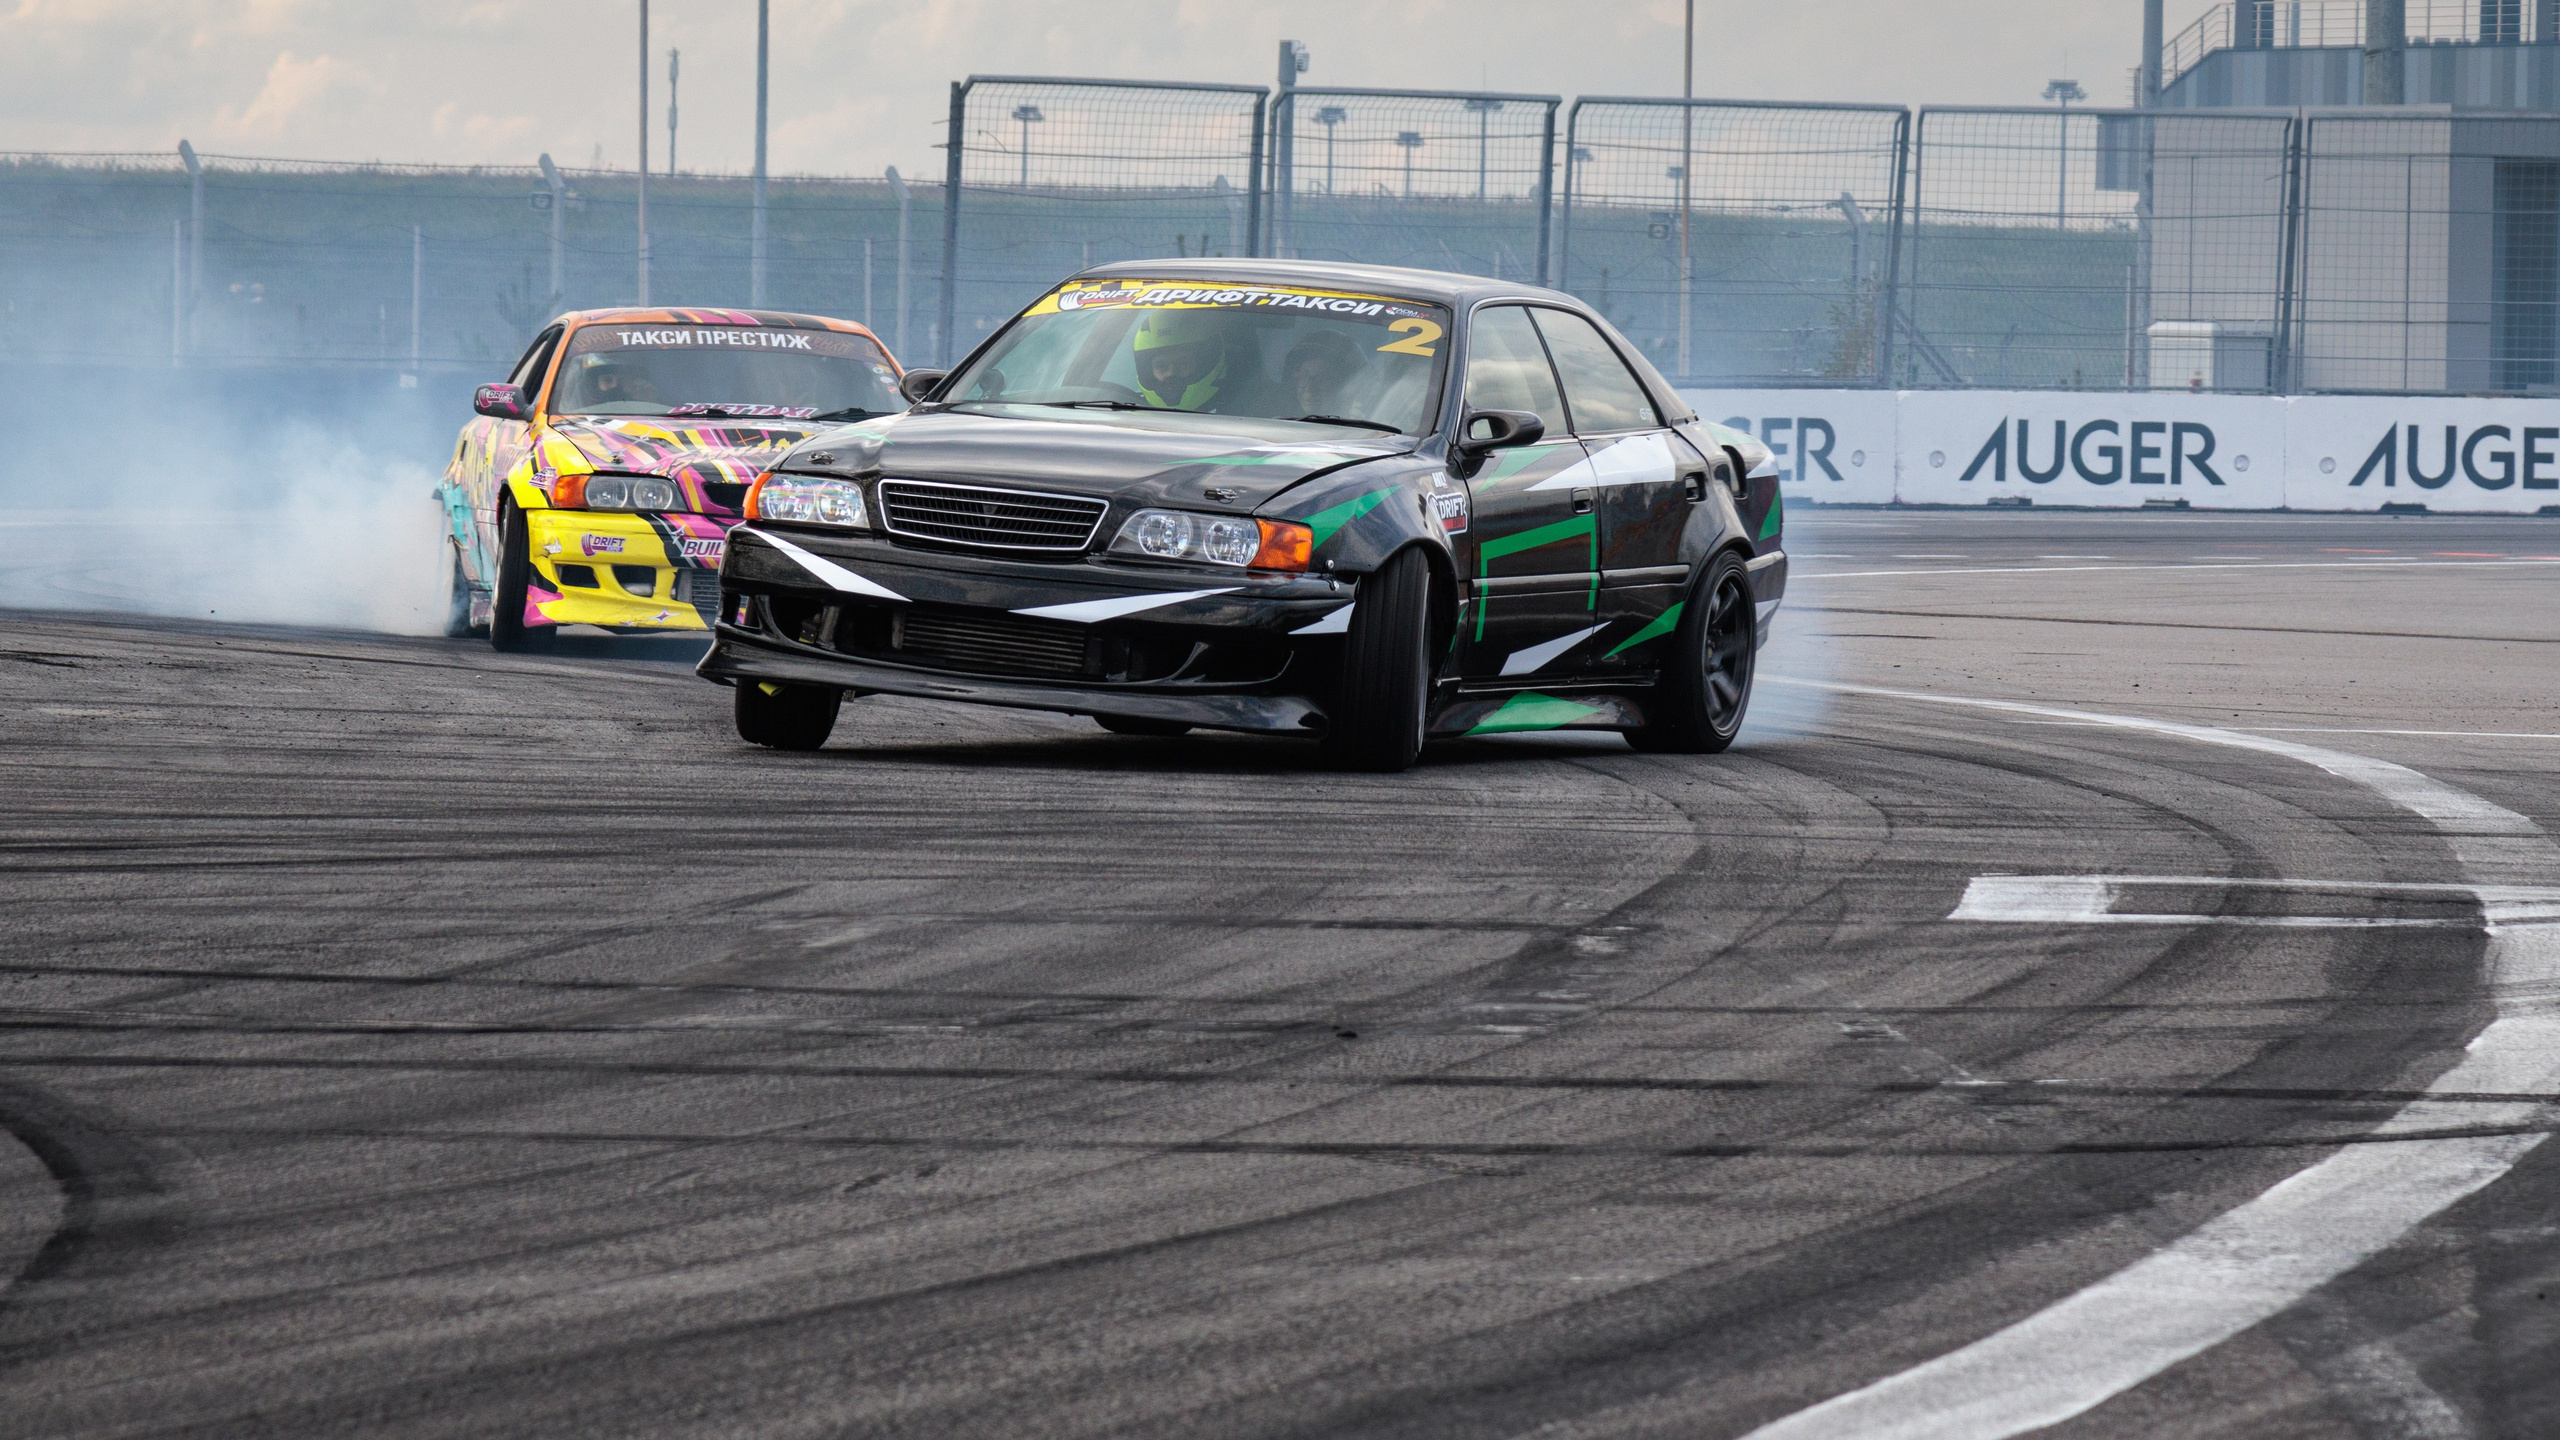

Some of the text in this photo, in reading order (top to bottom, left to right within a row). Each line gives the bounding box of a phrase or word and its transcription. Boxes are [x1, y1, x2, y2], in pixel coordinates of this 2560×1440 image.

[1080, 290, 1142, 300] DRIFT
[1268, 293, 1385, 316] ТАКСИ
[617, 331, 691, 345] ТАКСИ
[696, 331, 812, 350] ПРЕСТИЖ
[1376, 318, 1442, 357] 2
[490, 391, 514, 399] DRIFT
[1721, 416, 1845, 481] ER
[1959, 415, 2227, 486] AUGER
[1438, 497, 1463, 519] DRIFT
[593, 536, 625, 547] DRIFT
[683, 541, 726, 556] BUIL
